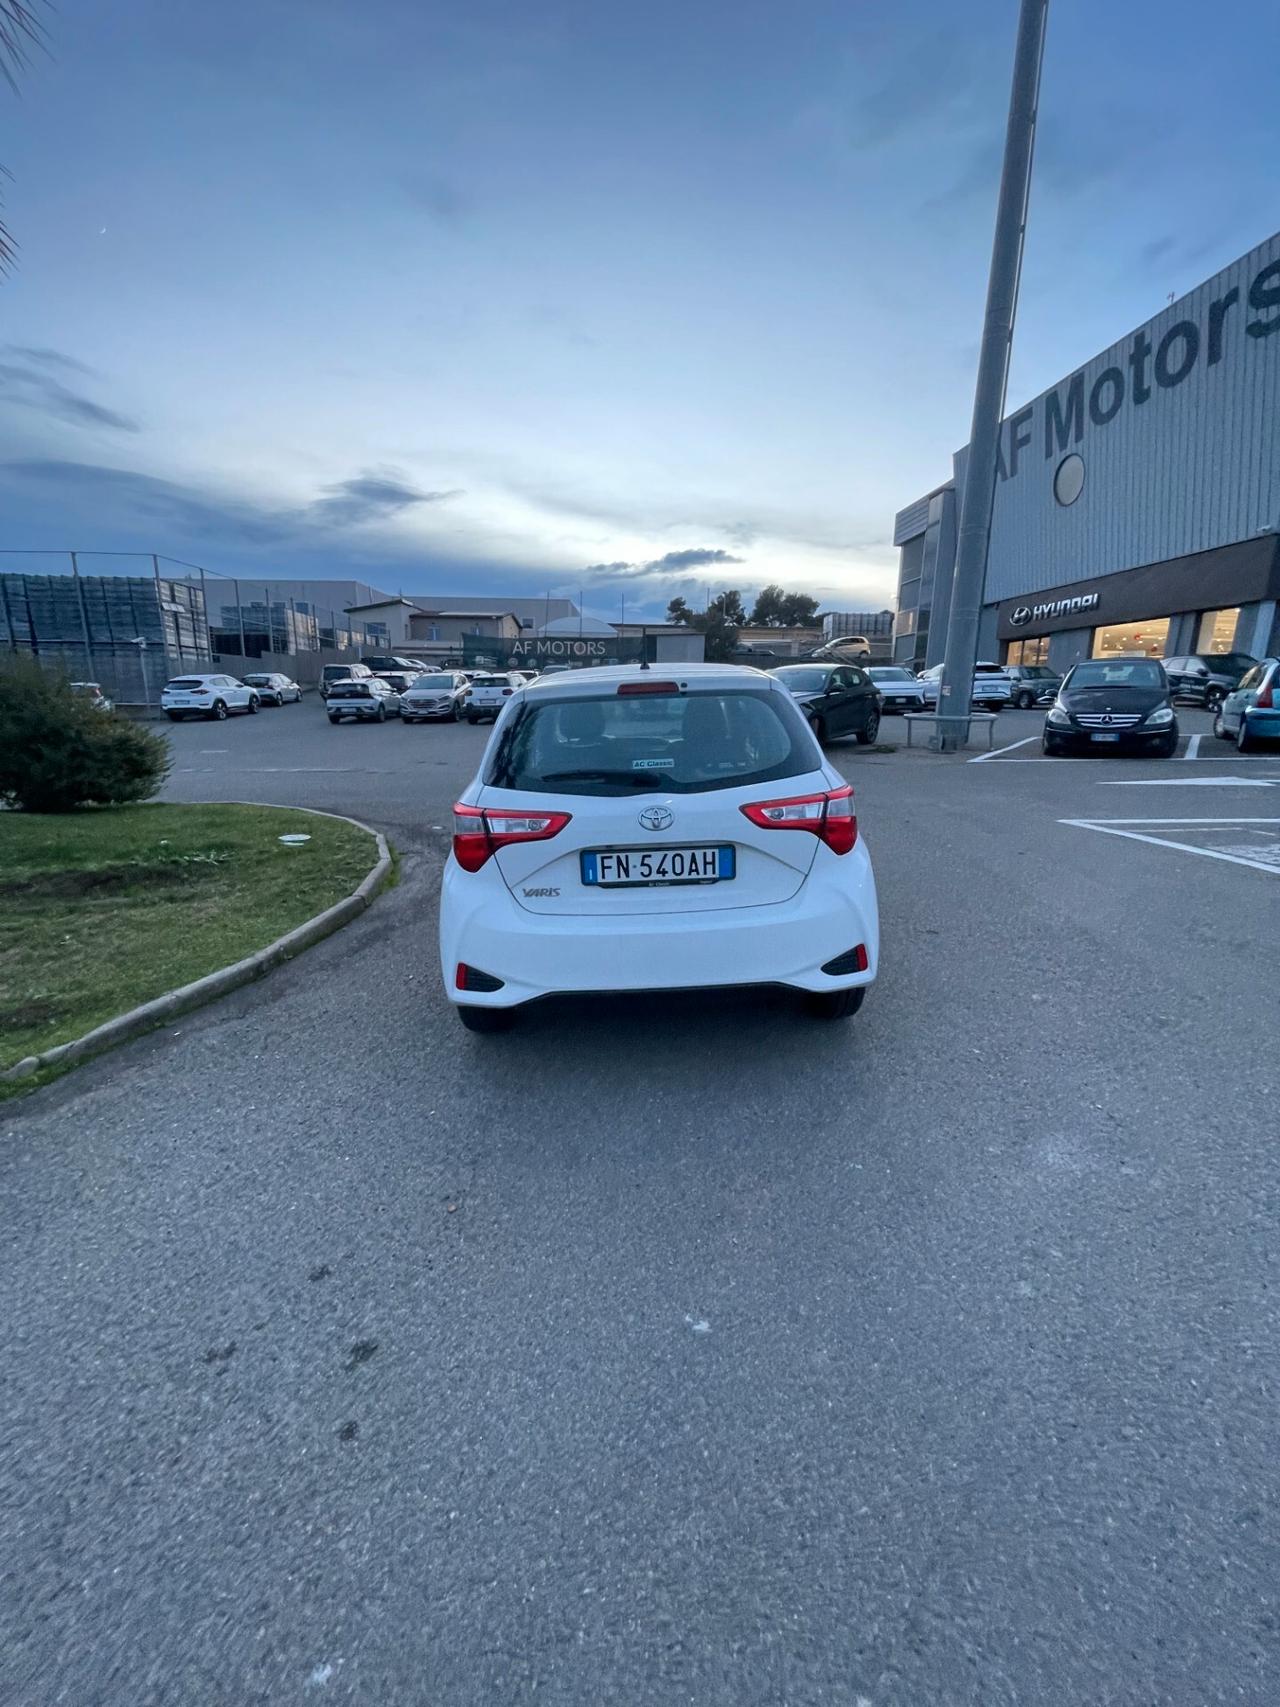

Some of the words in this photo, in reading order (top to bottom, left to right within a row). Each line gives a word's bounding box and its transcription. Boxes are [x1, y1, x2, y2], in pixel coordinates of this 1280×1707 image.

[1033, 593, 1099, 616] HYUNDAI
[512, 641, 533, 655] AF
[537, 640, 606, 656] MOTORS
[522, 887, 561, 898] YARIS
